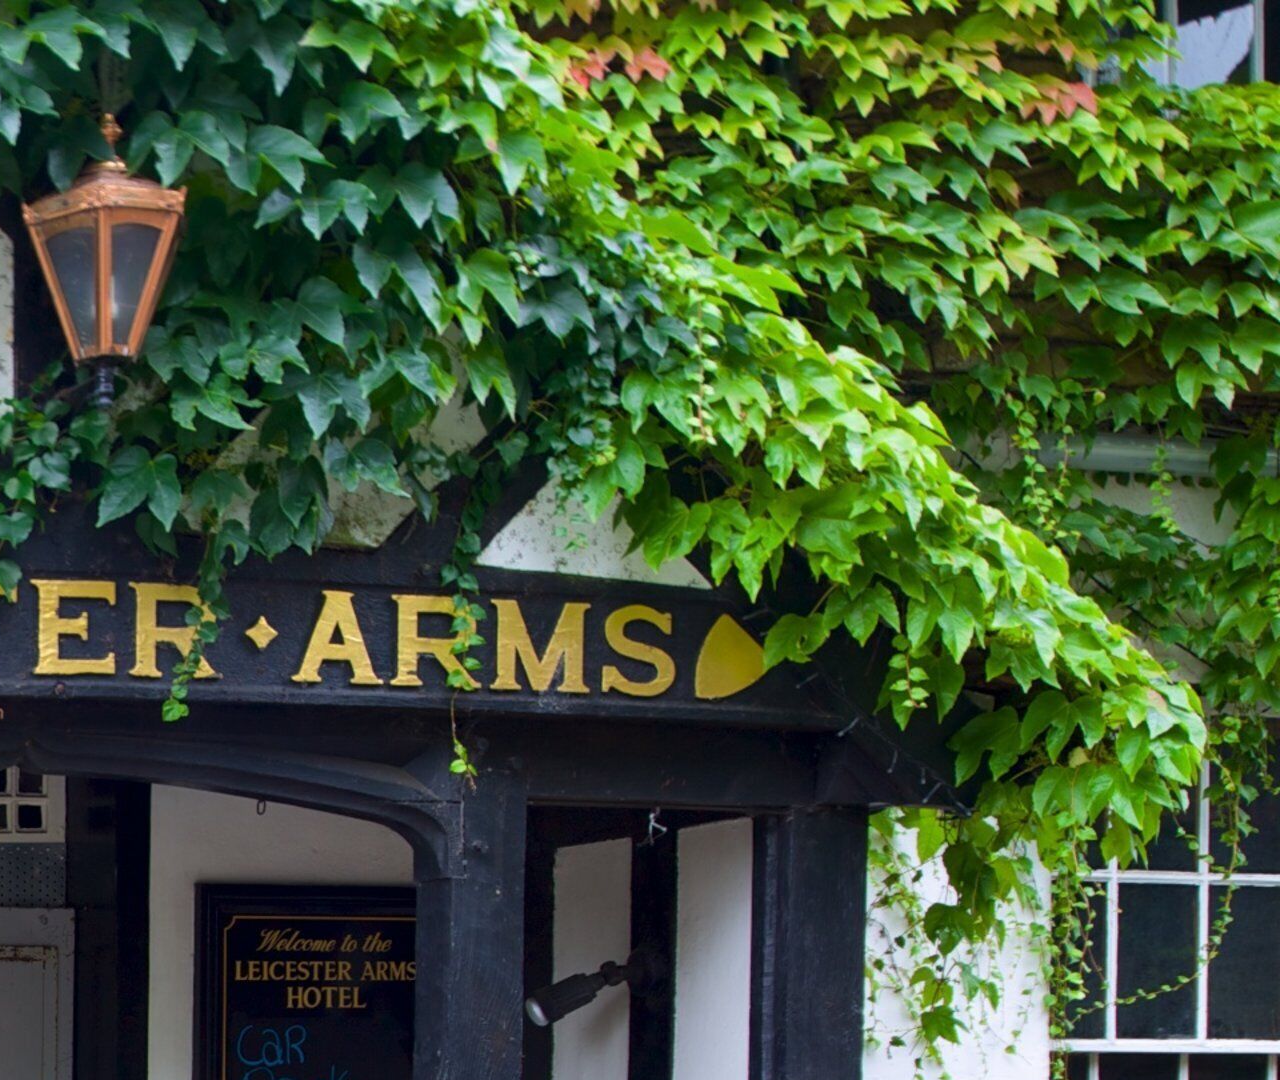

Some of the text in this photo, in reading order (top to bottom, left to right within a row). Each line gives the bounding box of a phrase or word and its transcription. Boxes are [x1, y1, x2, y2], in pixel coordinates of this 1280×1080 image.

[291, 589, 677, 697] ARMS
[256, 928, 392, 952] Welcome to the
[234, 960, 416, 981] LEICESTER ARMS
[286, 986, 367, 1009] HOTEL
